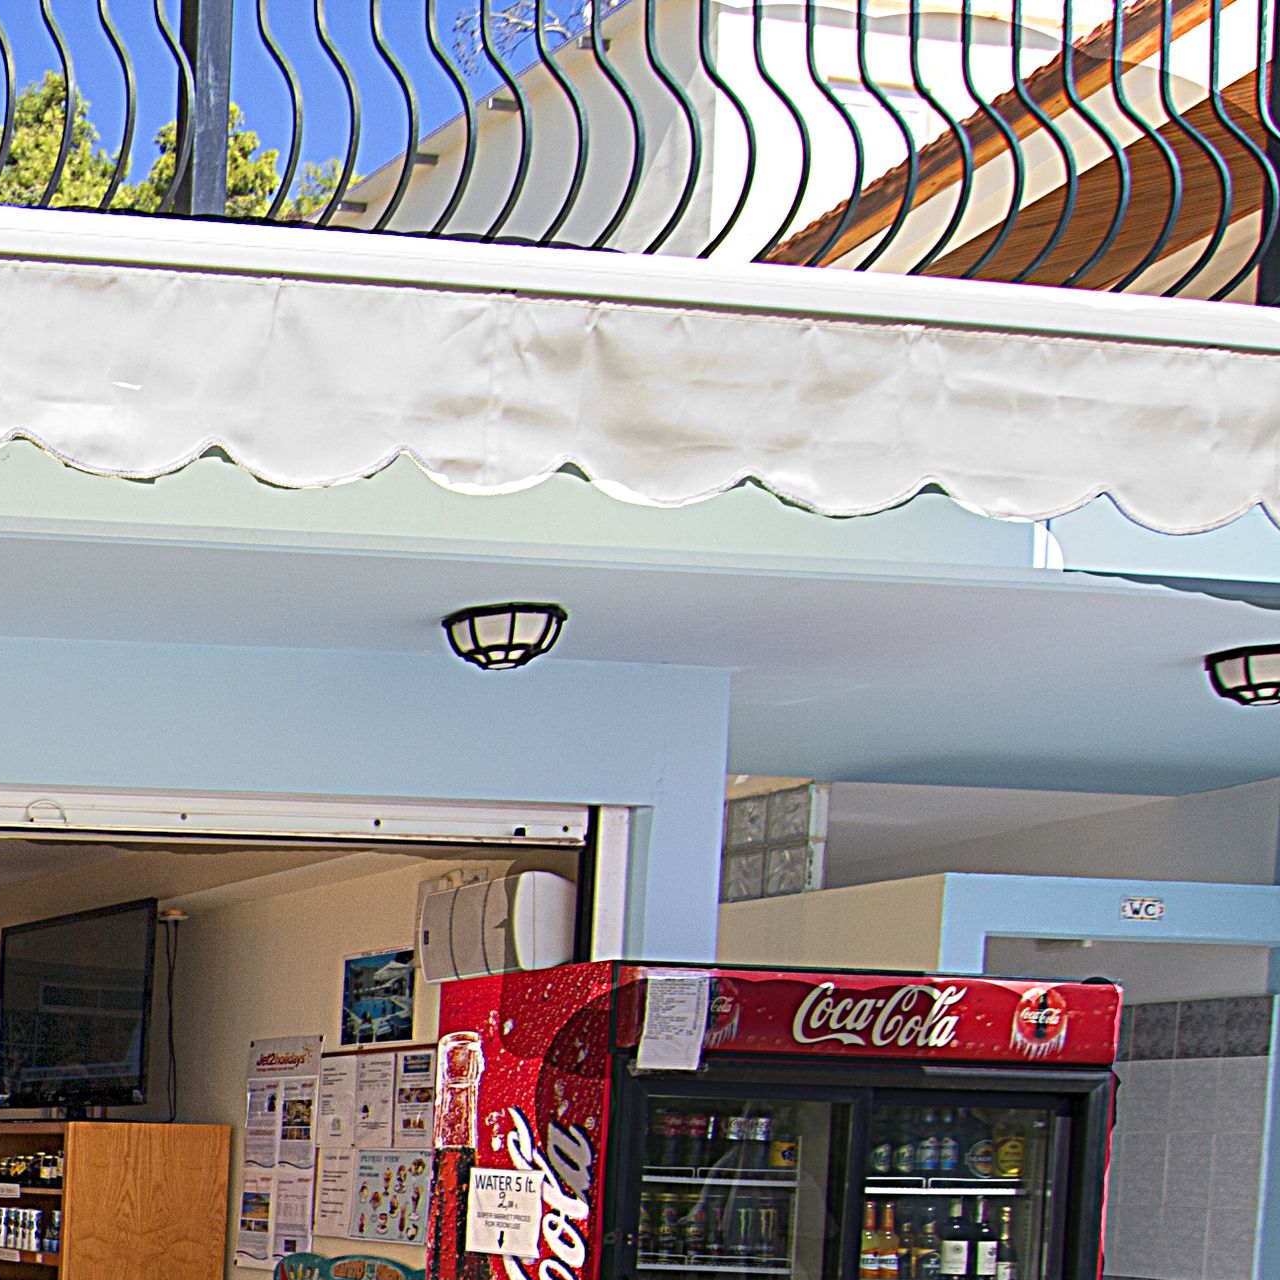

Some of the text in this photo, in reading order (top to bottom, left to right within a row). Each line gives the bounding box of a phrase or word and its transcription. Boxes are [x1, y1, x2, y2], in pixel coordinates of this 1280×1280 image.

[1129, 902, 1156, 916] WC
[793, 982, 968, 1048] Coca-Cola
[475, 1174, 512, 1191] WATER
[515, 1177, 522, 1192] 5
